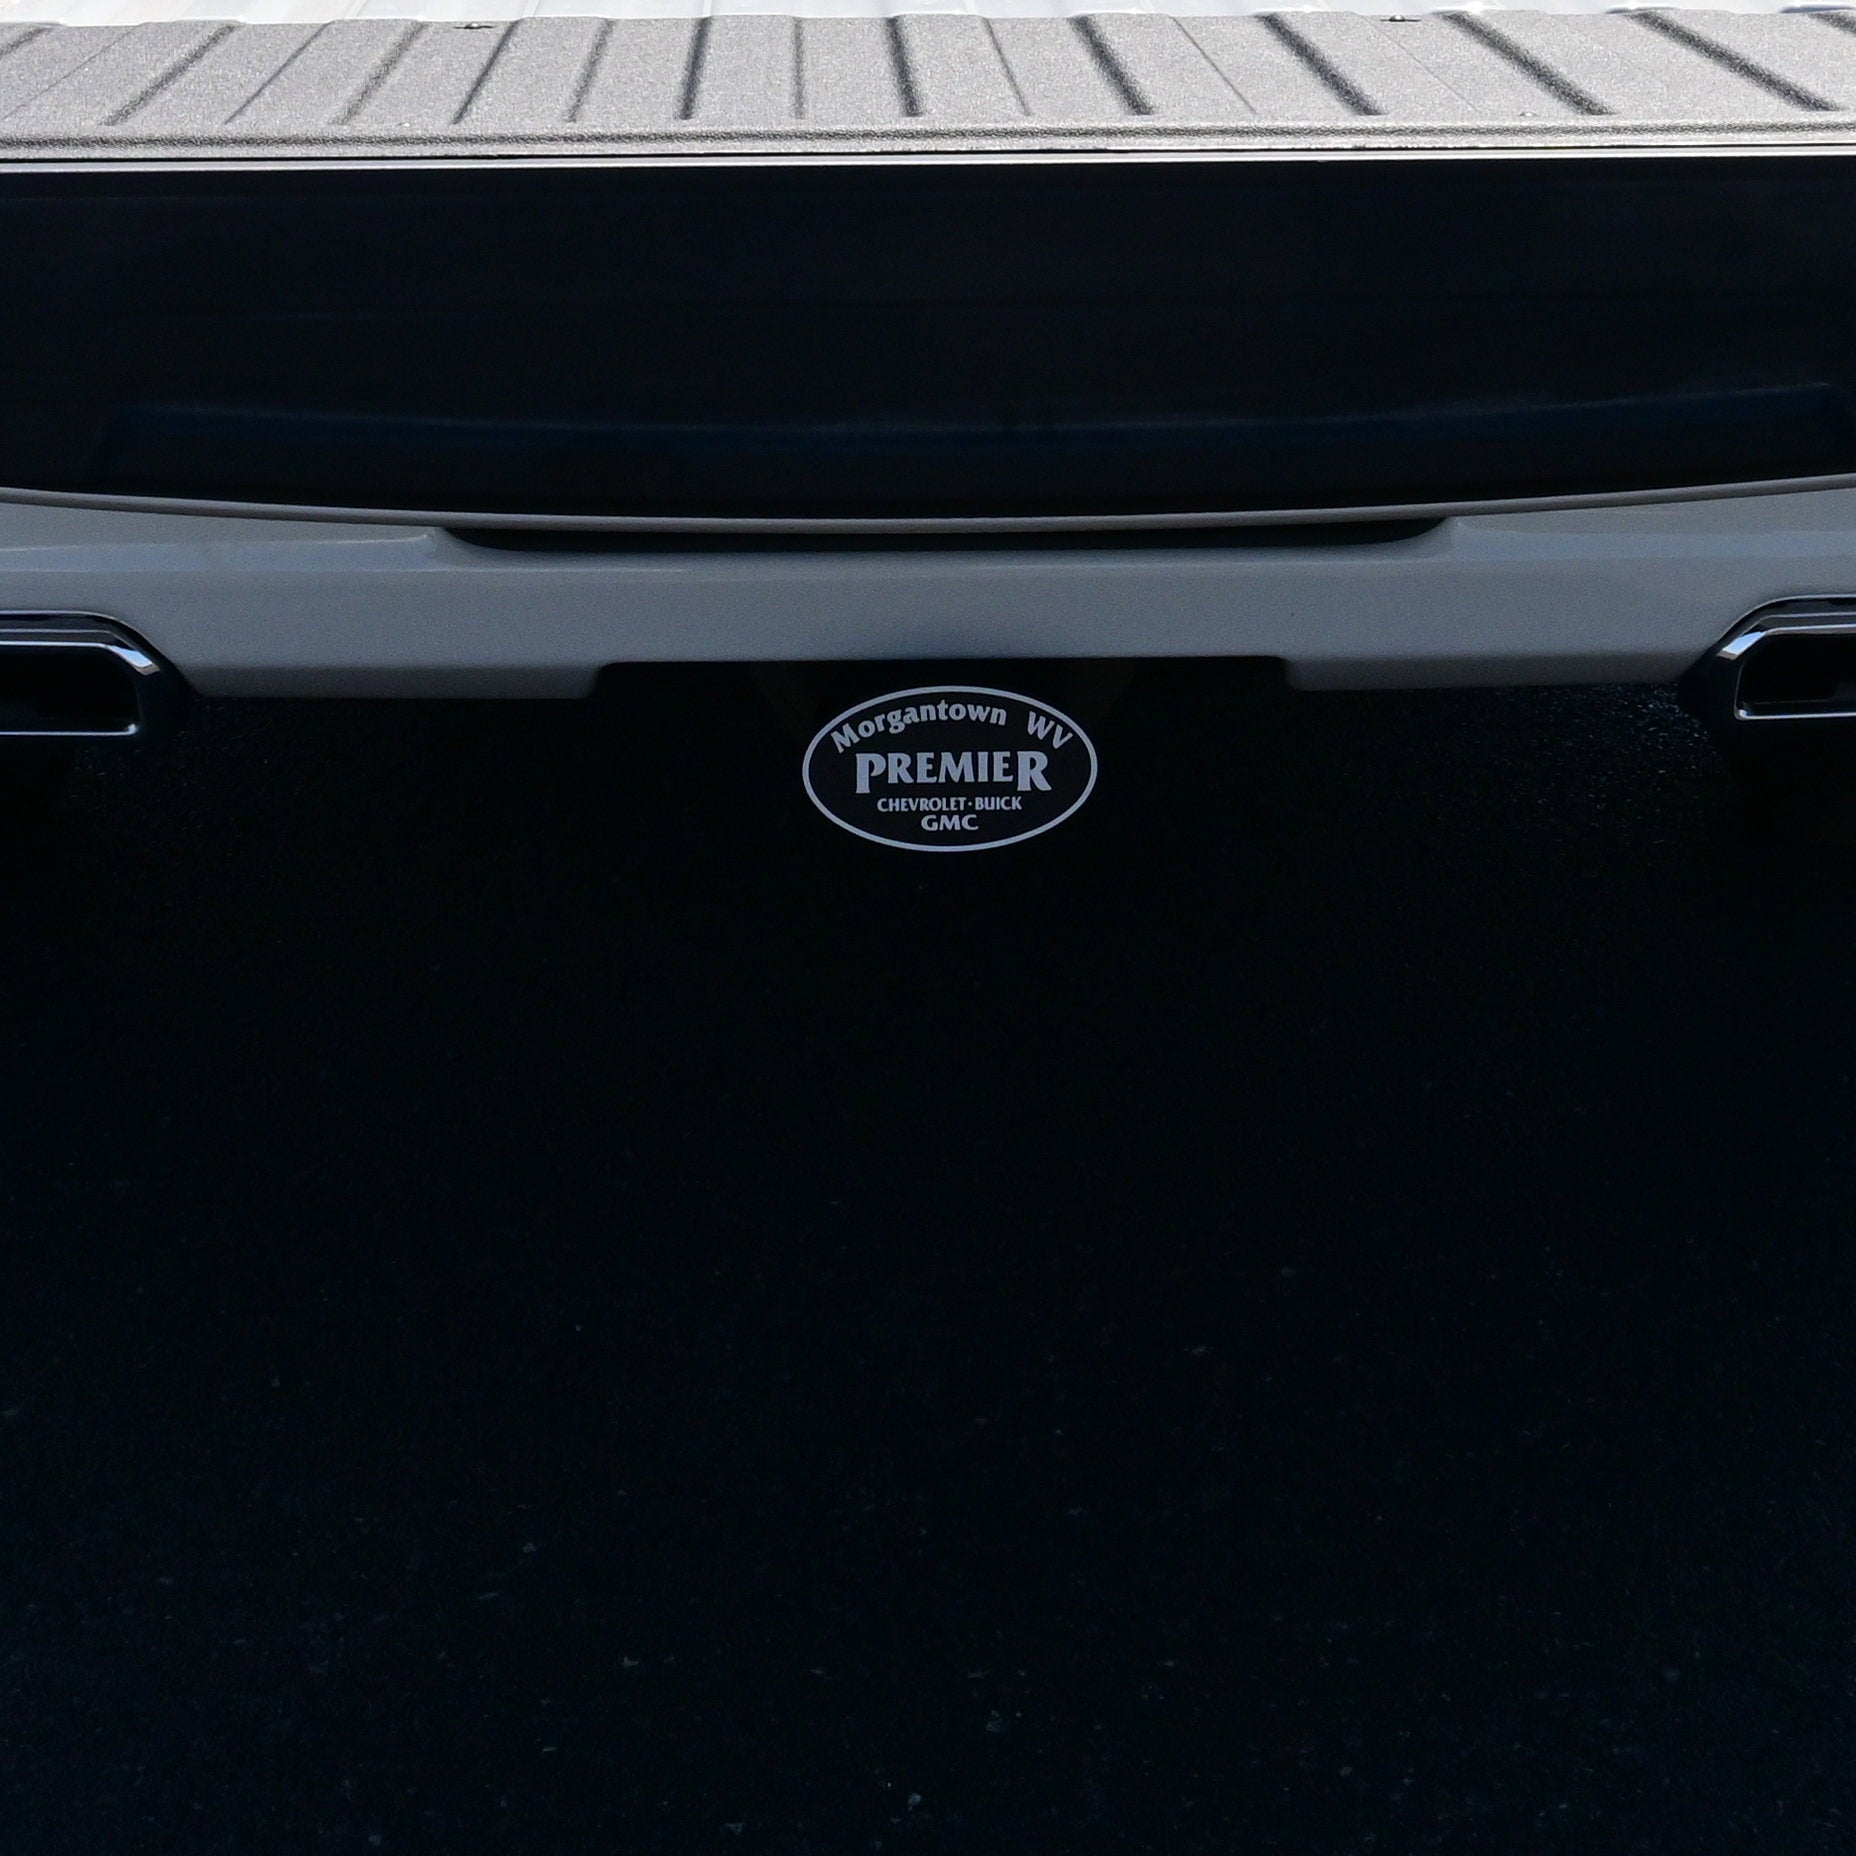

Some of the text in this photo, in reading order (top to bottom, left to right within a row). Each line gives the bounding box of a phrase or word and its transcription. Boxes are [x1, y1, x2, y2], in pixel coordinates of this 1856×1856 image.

[830, 699, 1073, 754] Morgantown WV
[855, 750, 1052, 794] PREMIER
[920, 814, 979, 831] GMC
